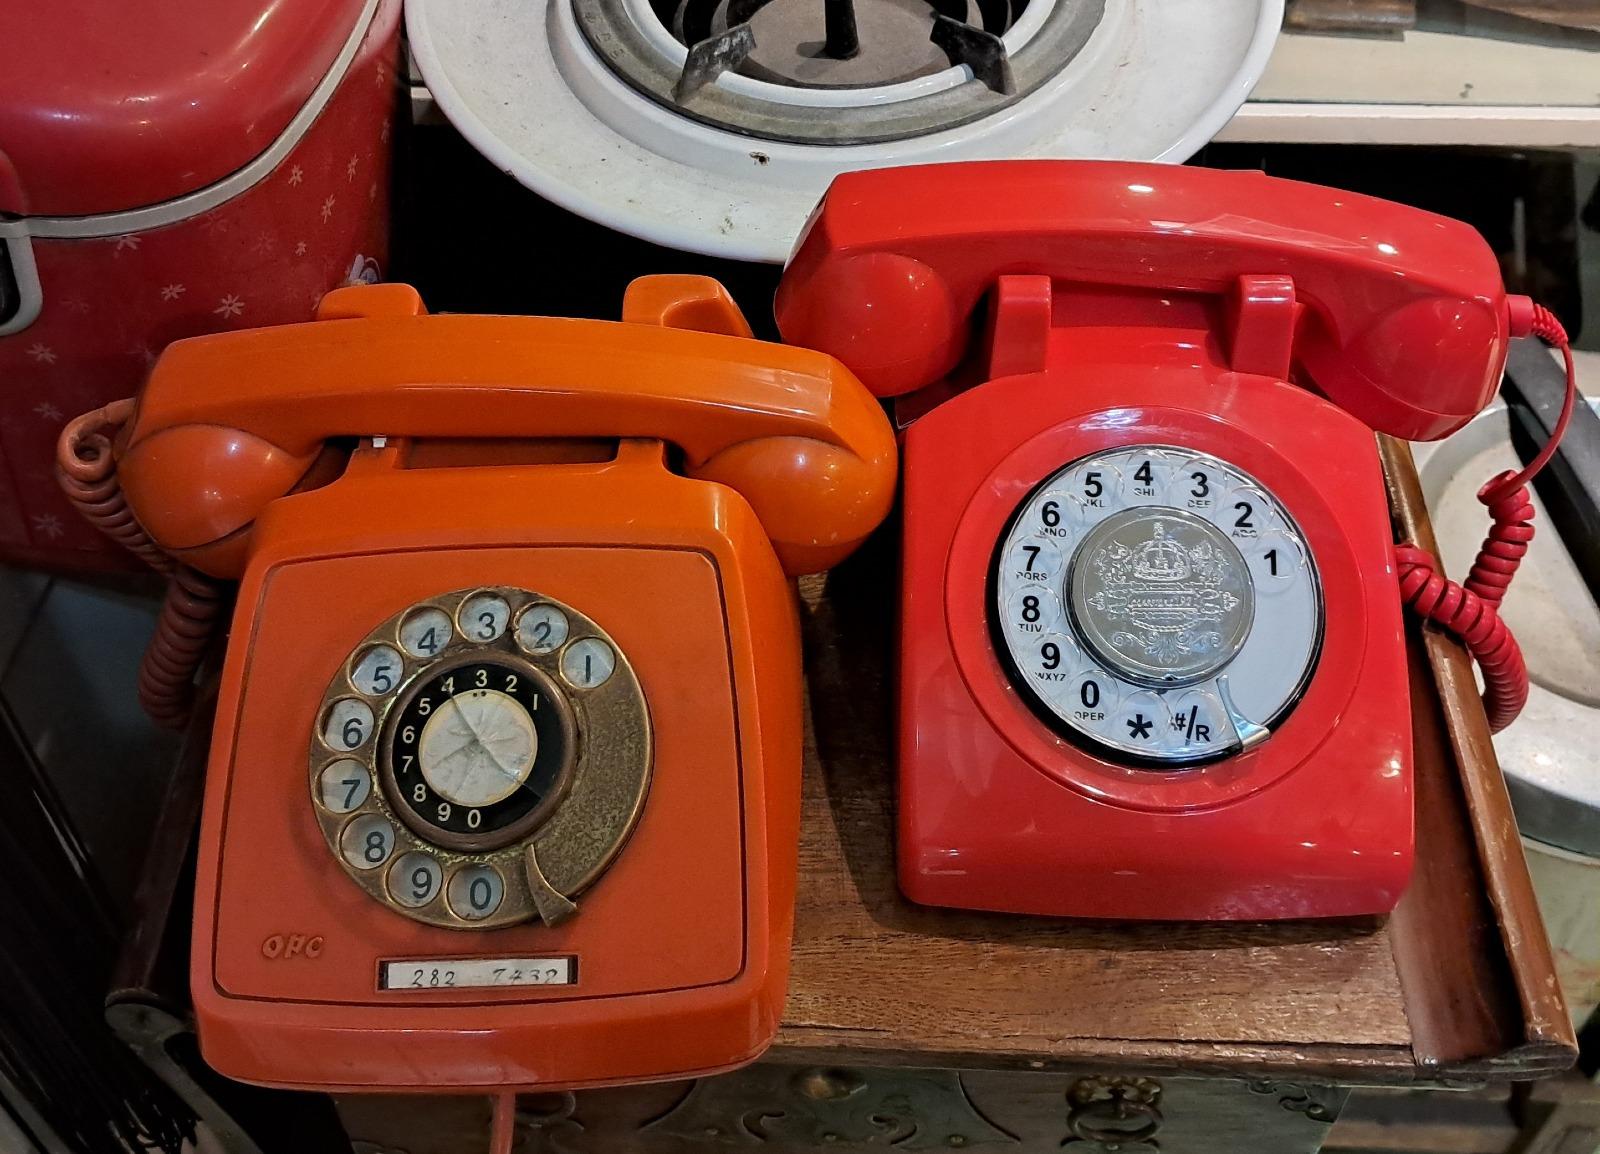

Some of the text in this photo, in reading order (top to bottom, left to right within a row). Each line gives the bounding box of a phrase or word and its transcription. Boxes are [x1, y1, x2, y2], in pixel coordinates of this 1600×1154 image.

[1084, 472, 1102, 498] 5
[1134, 461, 1153, 486] 4
[1191, 472, 1209, 497] 3
[1042, 501, 1060, 527] 6
[1234, 502, 1253, 527] 2
[1022, 546, 1041, 572] 7
[1263, 549, 1277, 576] 1
[1022, 596, 1040, 622] 8
[478, 612, 496, 640] 3
[534, 622, 551, 649] 2
[417, 628, 437, 654] 4
[1041, 642, 1060, 669] 9
[372, 666, 392, 694] 5
[476, 670, 487, 687] 3
[585, 655, 591, 683] 1
[440, 677, 455, 693] 4
[506, 676, 517, 691] 2
[1080, 680, 1099, 708] 0
[418, 698, 431, 715] 5
[533, 694, 538, 709] 1
[342, 718, 363, 748] 6
[402, 726, 415, 743] 6
[402, 756, 413, 773] 7
[342, 779, 361, 809] 7
[413, 784, 426, 802] 8
[437, 803, 451, 821] 9
[467, 810, 481, 828] 0
[364, 832, 386, 862] 8
[412, 867, 432, 899] 9
[470, 878, 491, 909] 0
[412, 969, 455, 987] 282
